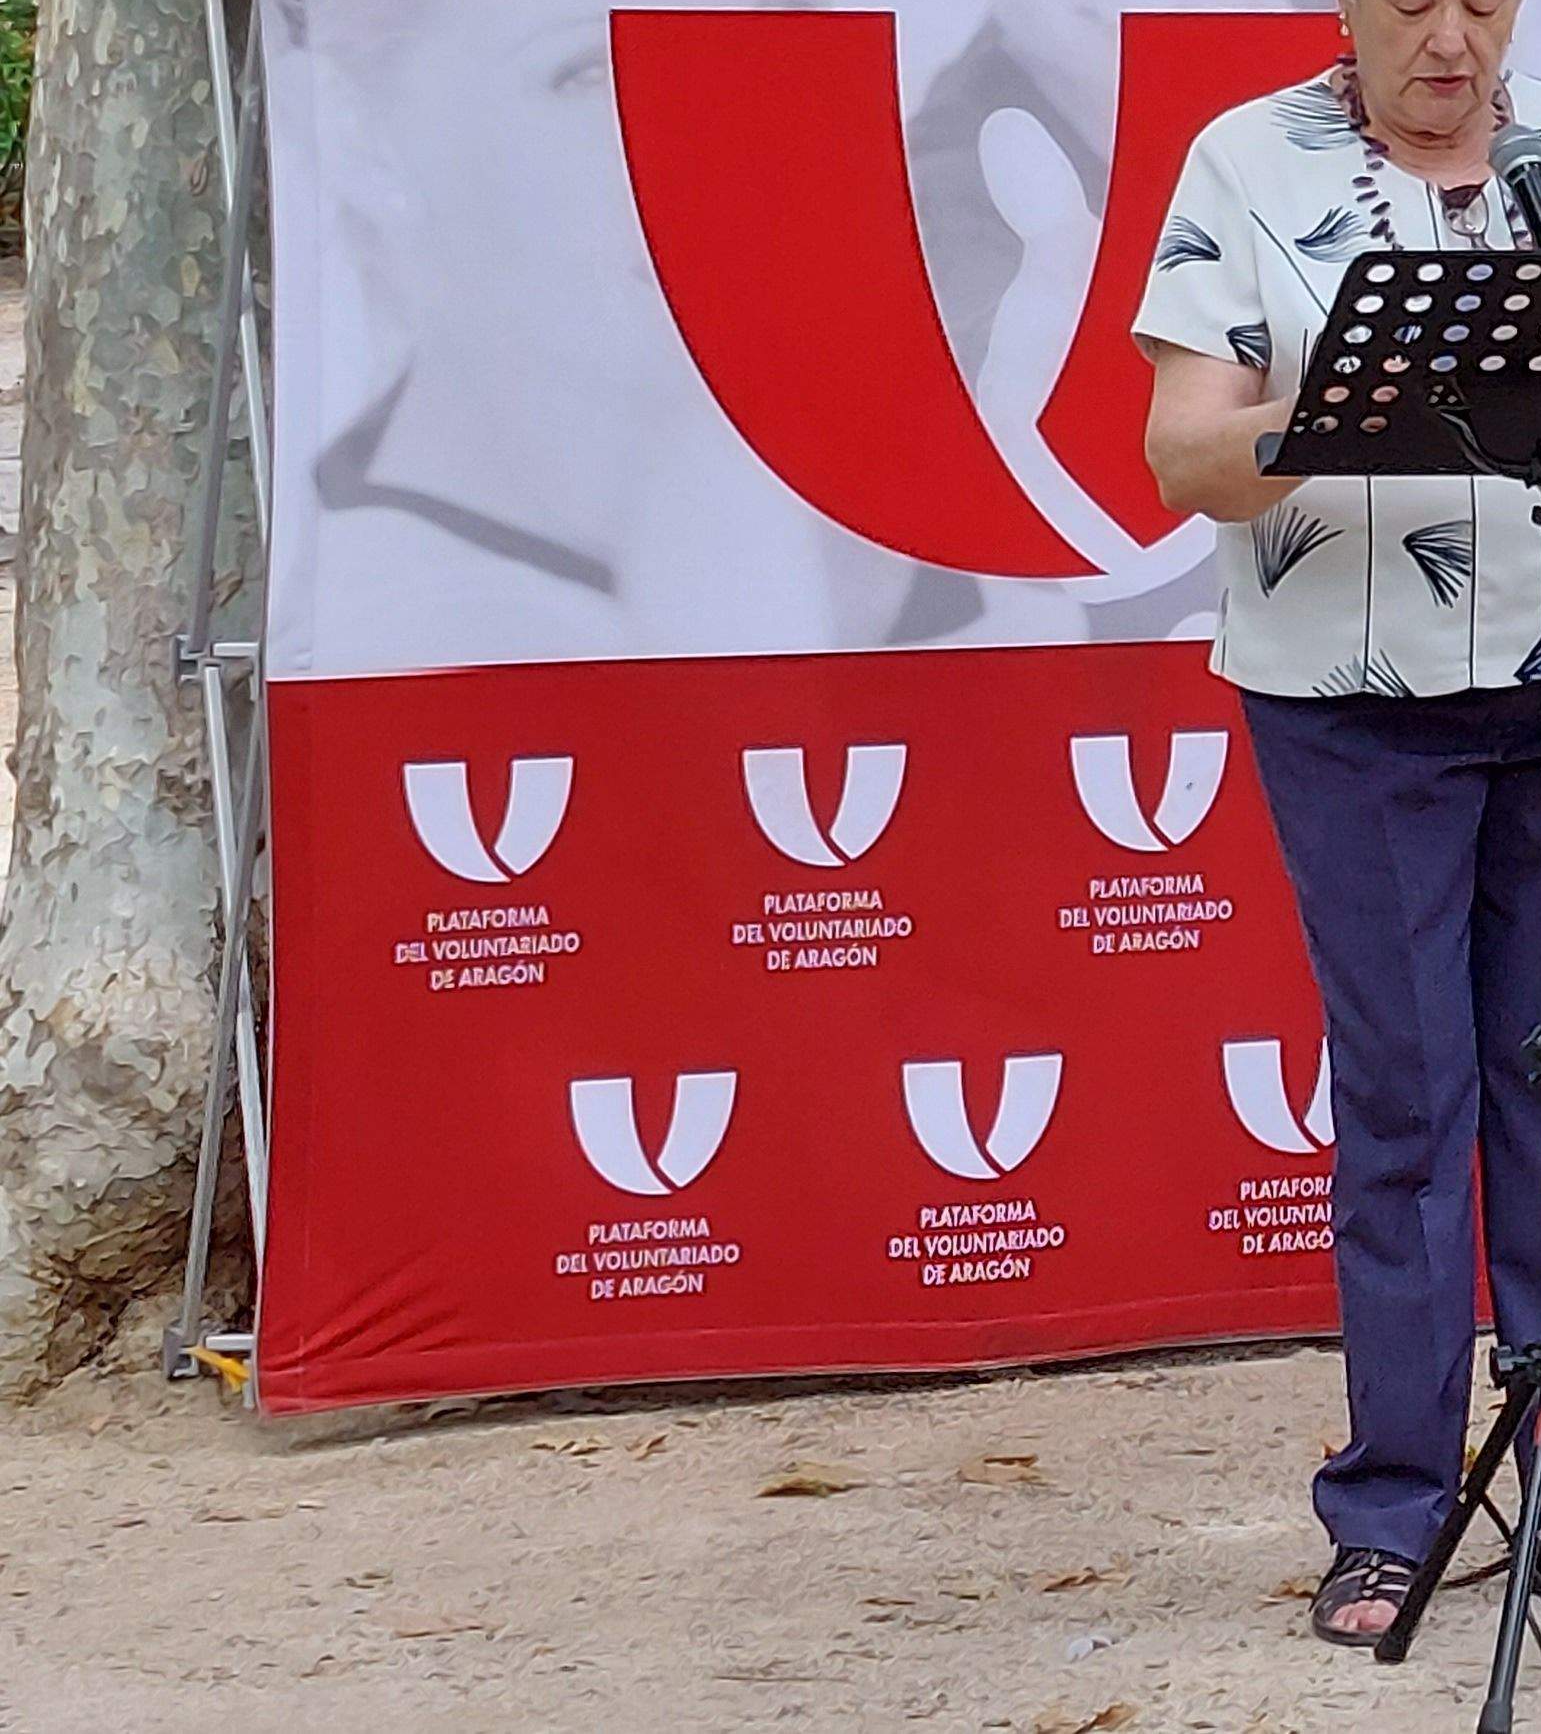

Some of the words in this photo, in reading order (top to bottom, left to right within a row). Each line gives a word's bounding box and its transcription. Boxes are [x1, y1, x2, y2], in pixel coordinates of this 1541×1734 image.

[1088, 872, 1205, 901] PLATAFORMA
[762, 888, 884, 917] PLATAFORMA
[1057, 905, 1092, 930] DEL
[1092, 898, 1234, 928] VOLUNTARIADO
[425, 904, 551, 934] PLATAFORMA
[731, 922, 767, 945] DEL
[766, 914, 914, 944] VOLUNTARIADO
[430, 930, 581, 962] VOLUNTARIADO
[1116, 923, 1202, 954] ARAGÓN
[765, 948, 793, 972] DE
[793, 941, 879, 970] ARAGÓN
[456, 958, 546, 989] ARAGÓN
[918, 1198, 1038, 1230] PLATAFORMA
[1207, 1207, 1242, 1232] DEL
[587, 1216, 711, 1247] PLATAFORMA
[887, 1234, 923, 1260] DEL
[922, 1224, 1066, 1260] VOLUNTARIADO
[1241, 1231, 1267, 1256] DE
[1266, 1224, 1336, 1254] ARAGÓ
[555, 1251, 590, 1276] DEL
[591, 1242, 741, 1273] VOLUNTARIADO
[921, 1262, 949, 1287] DE
[947, 1251, 1032, 1285] ARAGÓN
[589, 1277, 616, 1301] DE
[617, 1268, 705, 1299] ARAGÓN
